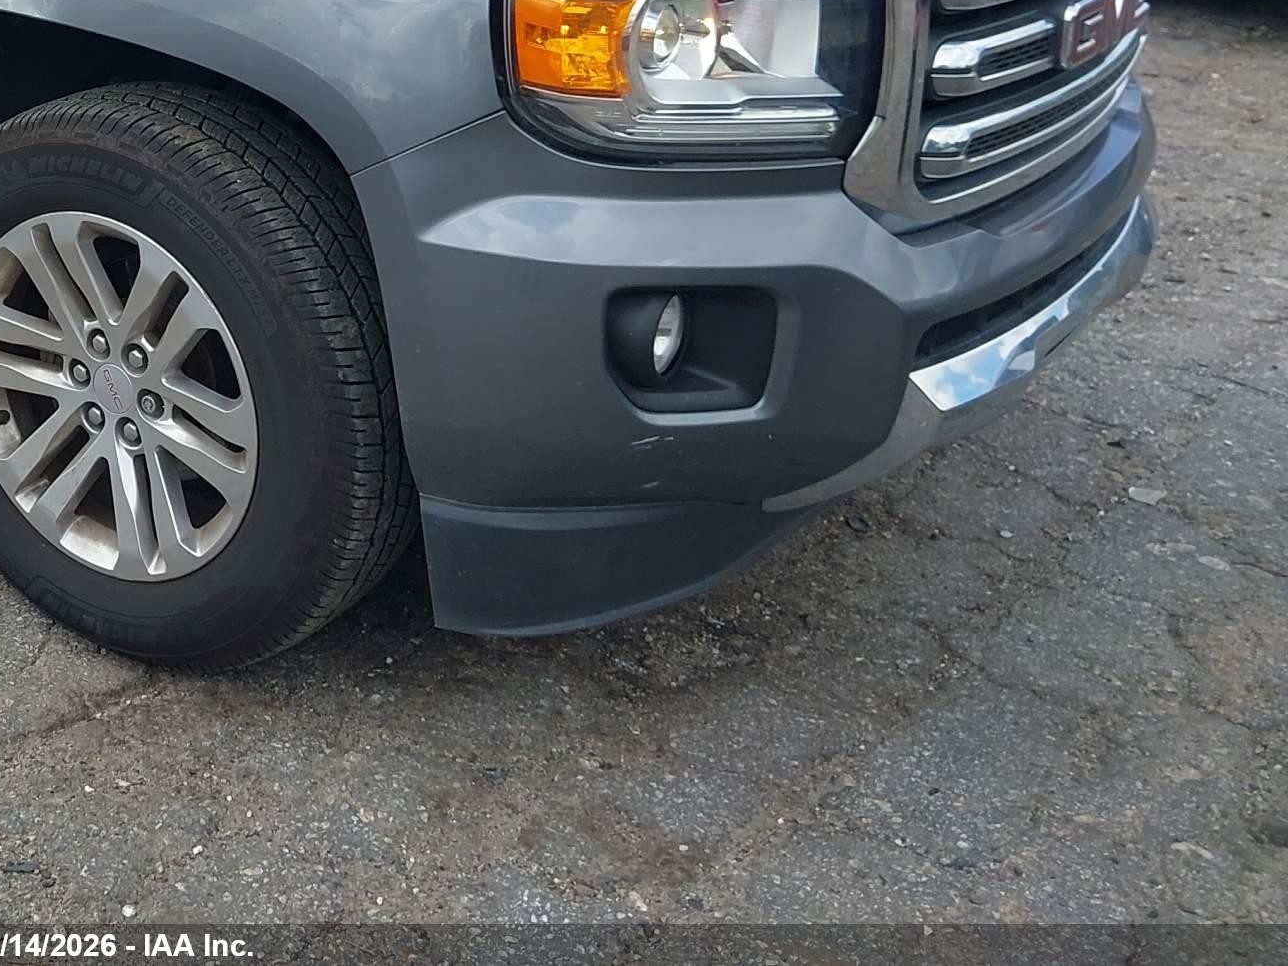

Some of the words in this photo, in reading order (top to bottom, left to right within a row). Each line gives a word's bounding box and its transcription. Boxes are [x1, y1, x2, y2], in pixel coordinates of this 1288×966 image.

[28, 155, 143, 194] MICHELIN
[165, 196, 229, 257] DEFENDER
[103, 368, 125, 411] GMC
